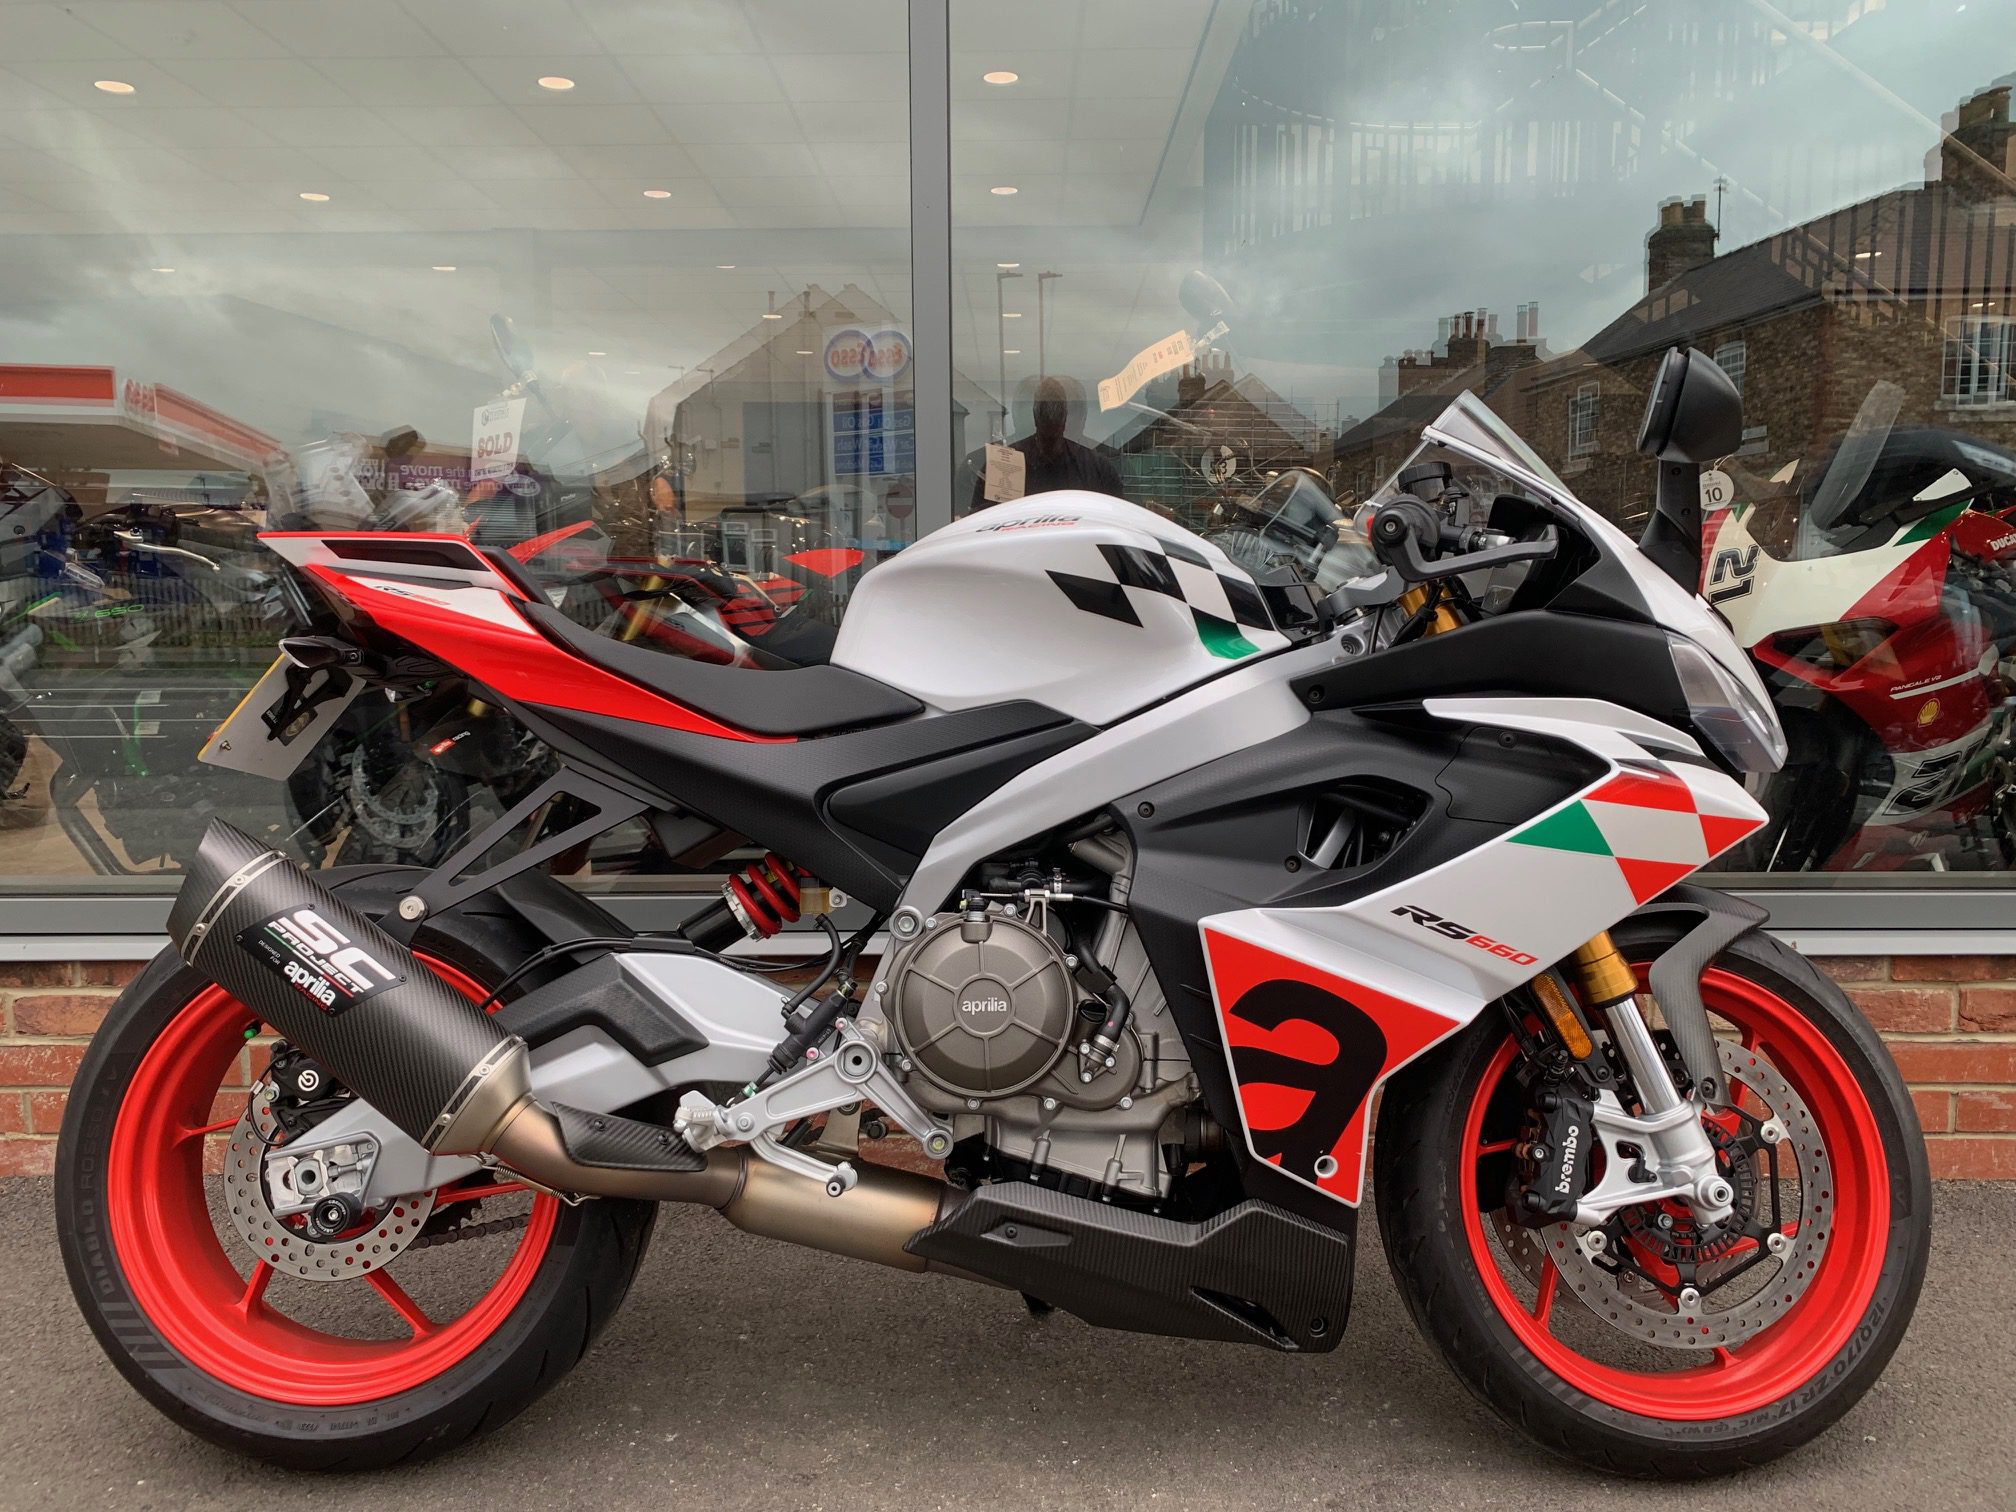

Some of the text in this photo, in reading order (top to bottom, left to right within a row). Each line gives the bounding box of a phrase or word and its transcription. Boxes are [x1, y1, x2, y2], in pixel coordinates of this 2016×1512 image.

[478, 431, 513, 458] SOLD
[1705, 487, 1723, 503] 10
[267, 921, 365, 993] PROJECT
[270, 955, 281, 966] FOR
[284, 960, 337, 1007] aprilia
[962, 997, 1007, 1016] aprilia
[81, 1110, 105, 1191] ROSSO
[1555, 1125, 1579, 1194] brembo
[81, 1202, 116, 1296] DIABLO
[1833, 1300, 1887, 1378] 120/70
[1799, 1379, 1830, 1402] ZR
[1778, 1401, 1798, 1419] 17
